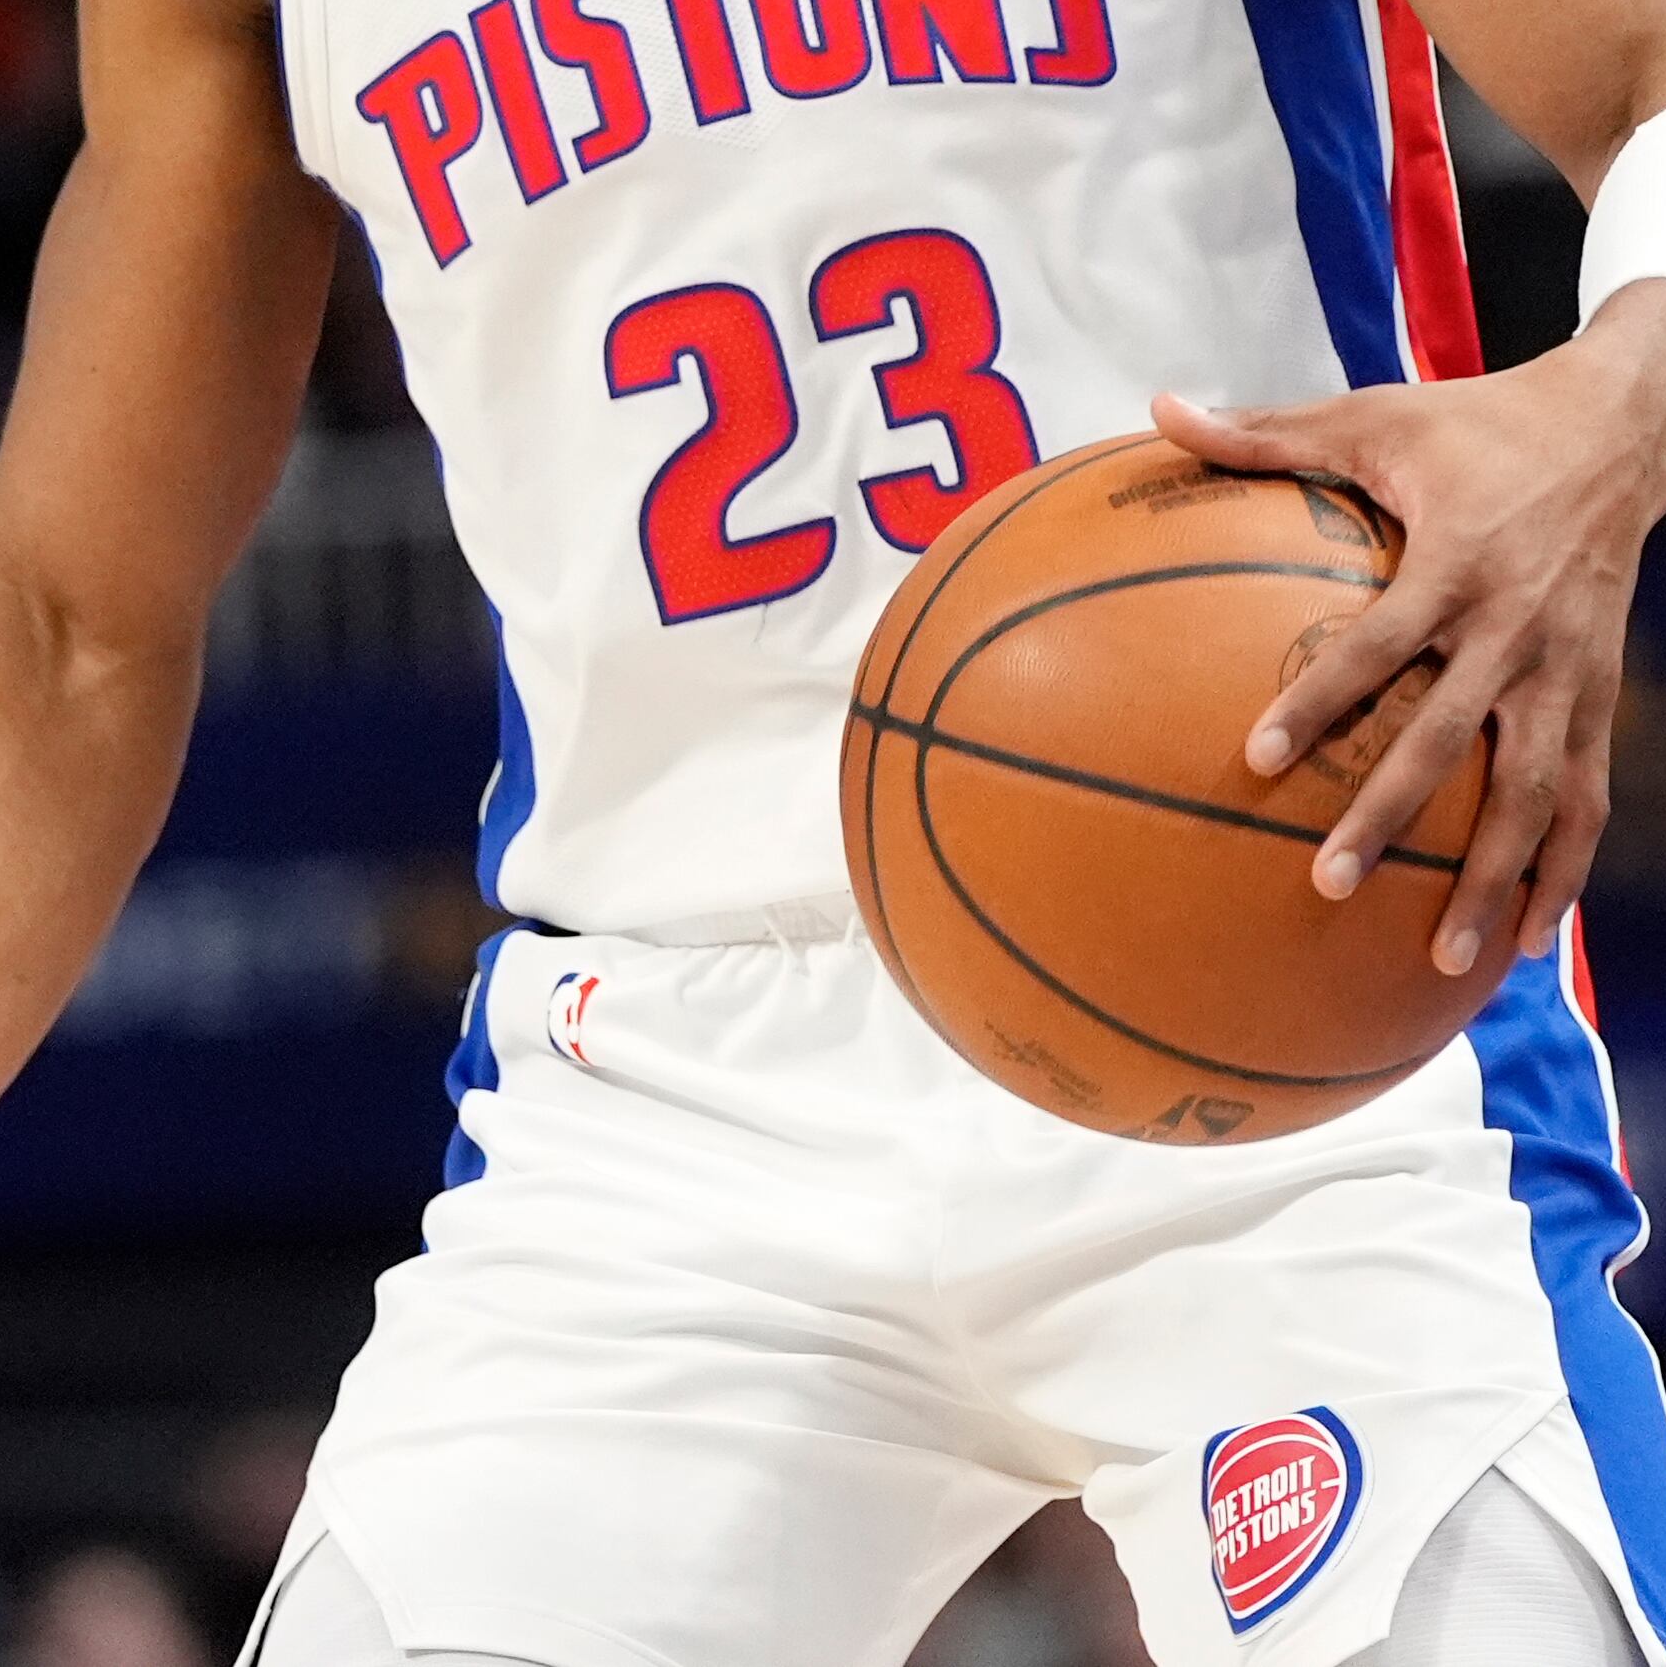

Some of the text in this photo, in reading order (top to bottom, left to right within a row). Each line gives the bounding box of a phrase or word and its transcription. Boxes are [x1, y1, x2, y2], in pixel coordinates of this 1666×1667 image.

[603, 226, 1040, 627] 23
[1211, 1454, 1317, 1538] DETROIT
[1215, 1489, 1317, 1575] PISTONS
